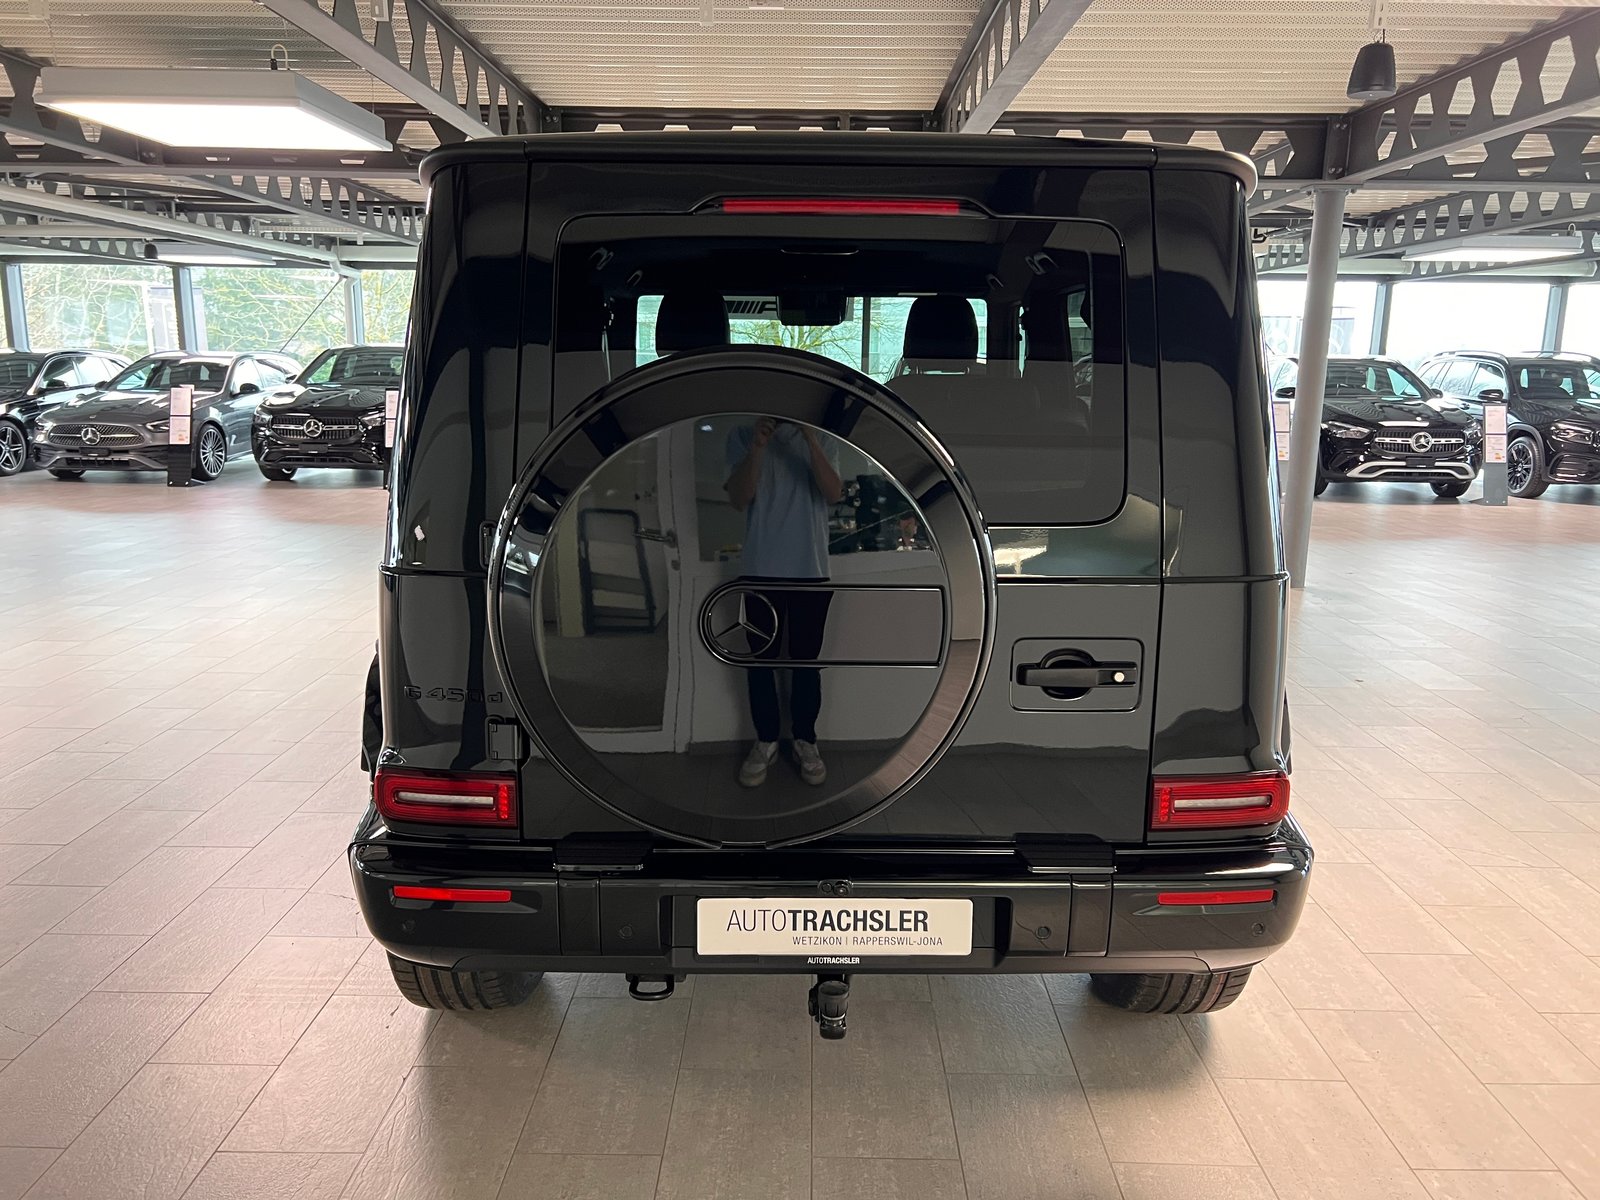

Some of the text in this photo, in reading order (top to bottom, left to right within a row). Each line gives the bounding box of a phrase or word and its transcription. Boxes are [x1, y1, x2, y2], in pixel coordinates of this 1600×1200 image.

[726, 909, 929, 932] AUTOTRACHSLER
[792, 936, 842, 946] WETZIKON
[852, 936, 943, 946] RAPPERSWIL-JONA
[807, 957, 860, 965] AUTOTRACHSLER
